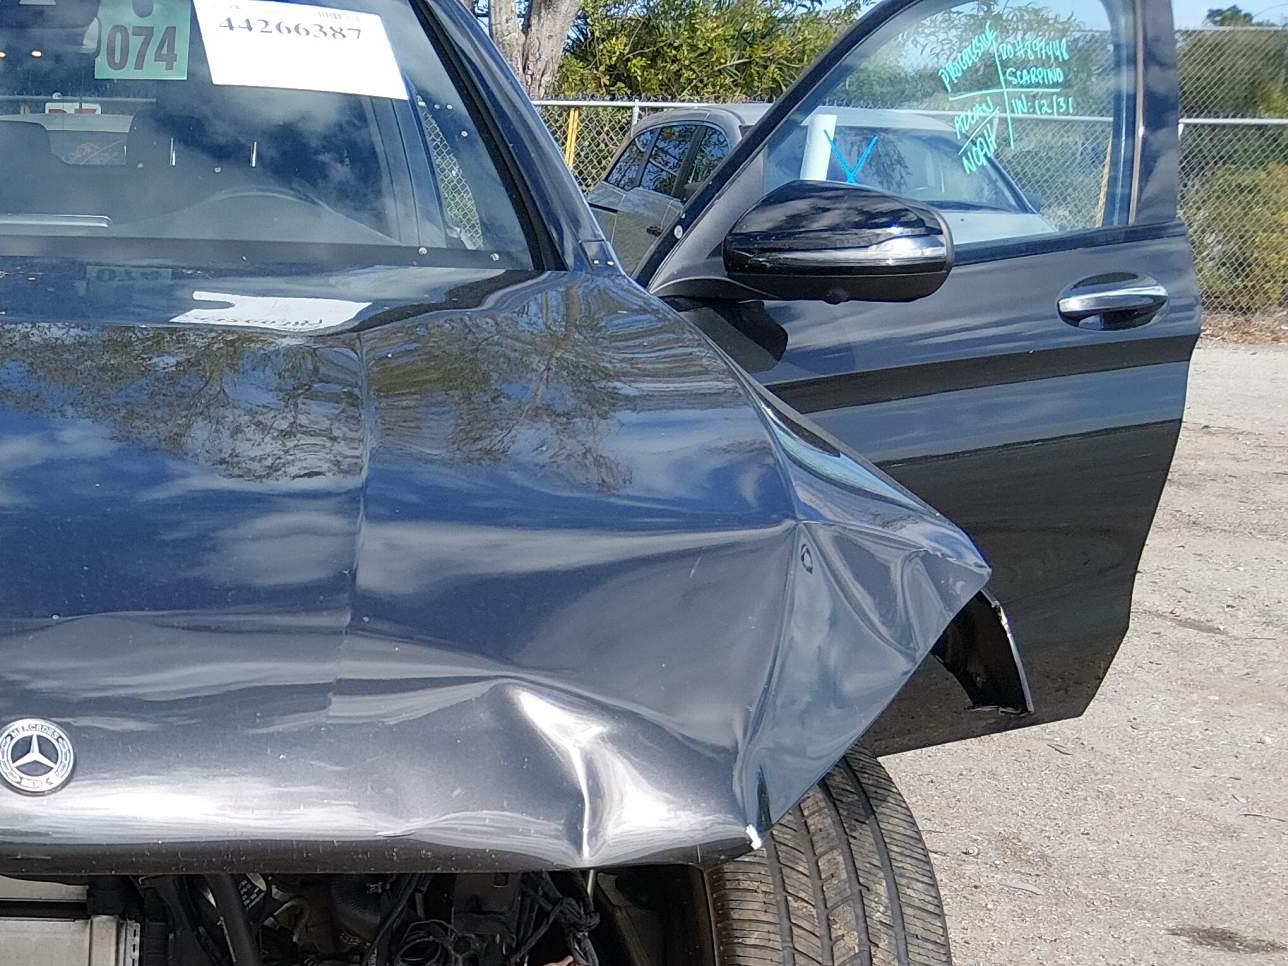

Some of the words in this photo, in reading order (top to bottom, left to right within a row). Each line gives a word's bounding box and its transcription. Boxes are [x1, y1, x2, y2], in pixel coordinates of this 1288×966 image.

[218, 15, 362, 40] 44266387
[106, 24, 178, 71] 074
[1034, 94, 1073, 117] 12/31
